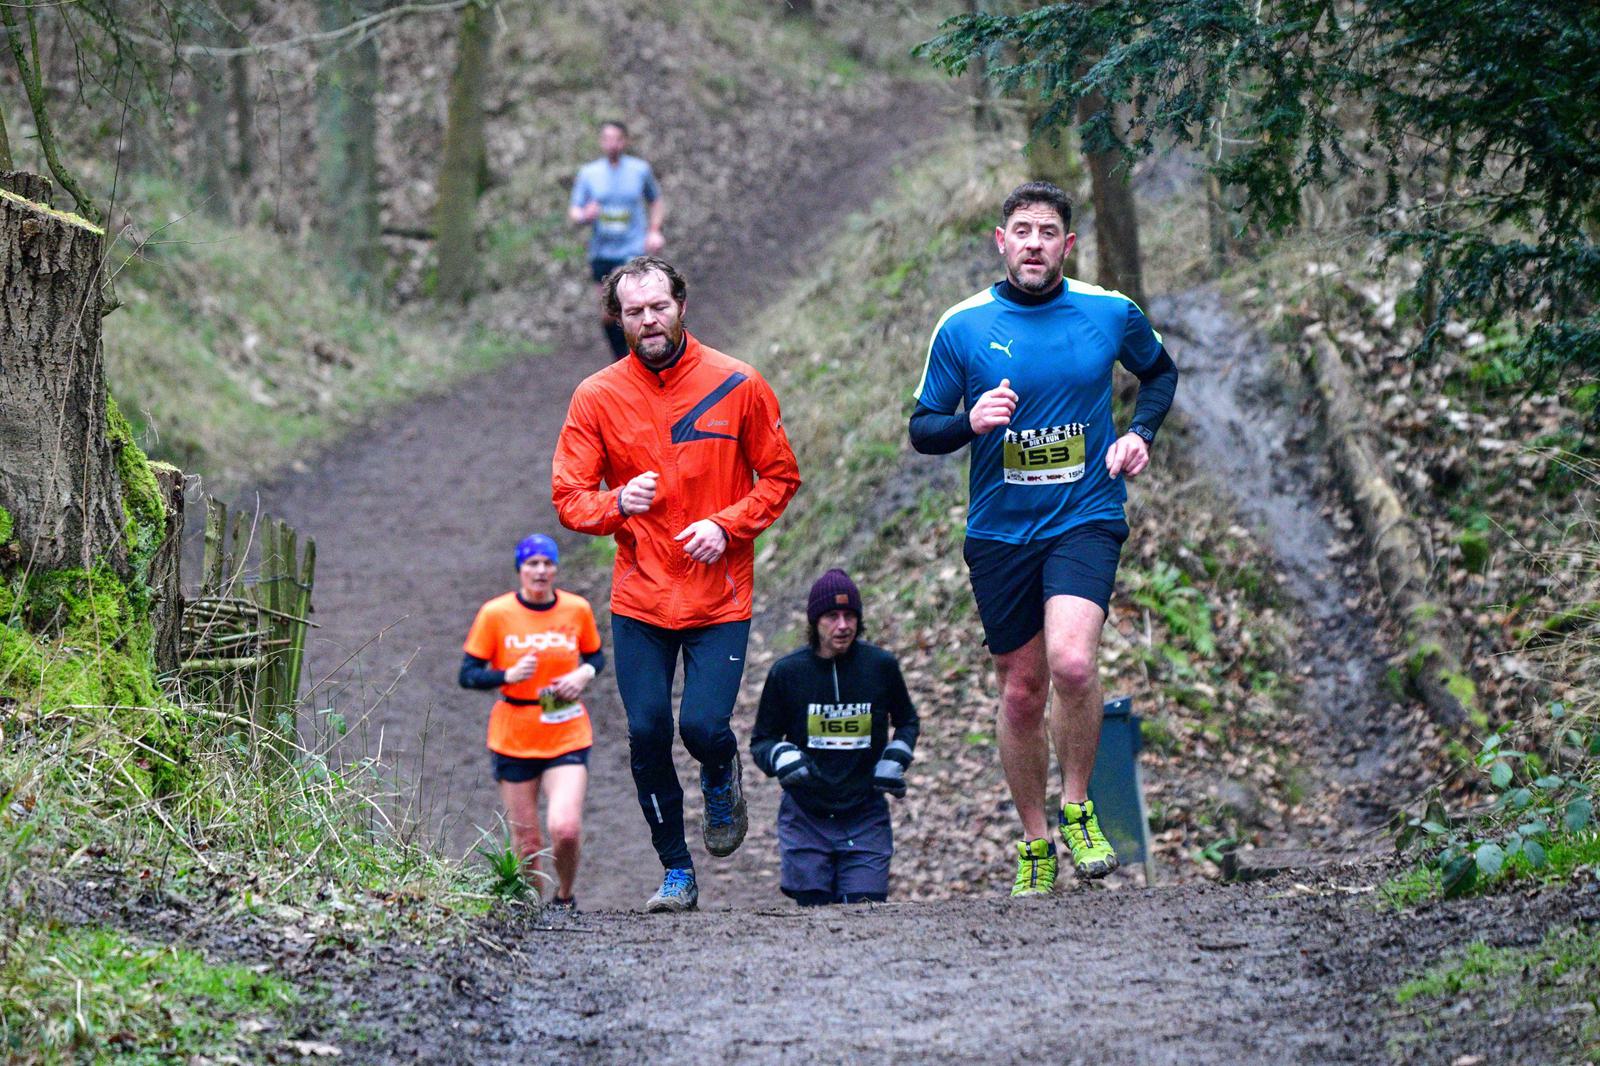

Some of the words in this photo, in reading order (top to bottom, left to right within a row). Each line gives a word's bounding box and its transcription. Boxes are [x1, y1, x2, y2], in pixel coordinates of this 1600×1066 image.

[1029, 436, 1045, 447] DIRT
[1046, 433, 1060, 443] RUN
[1017, 446, 1070, 466] 153
[504, 631, 577, 651] rugby
[820, 720, 860, 733] 166
